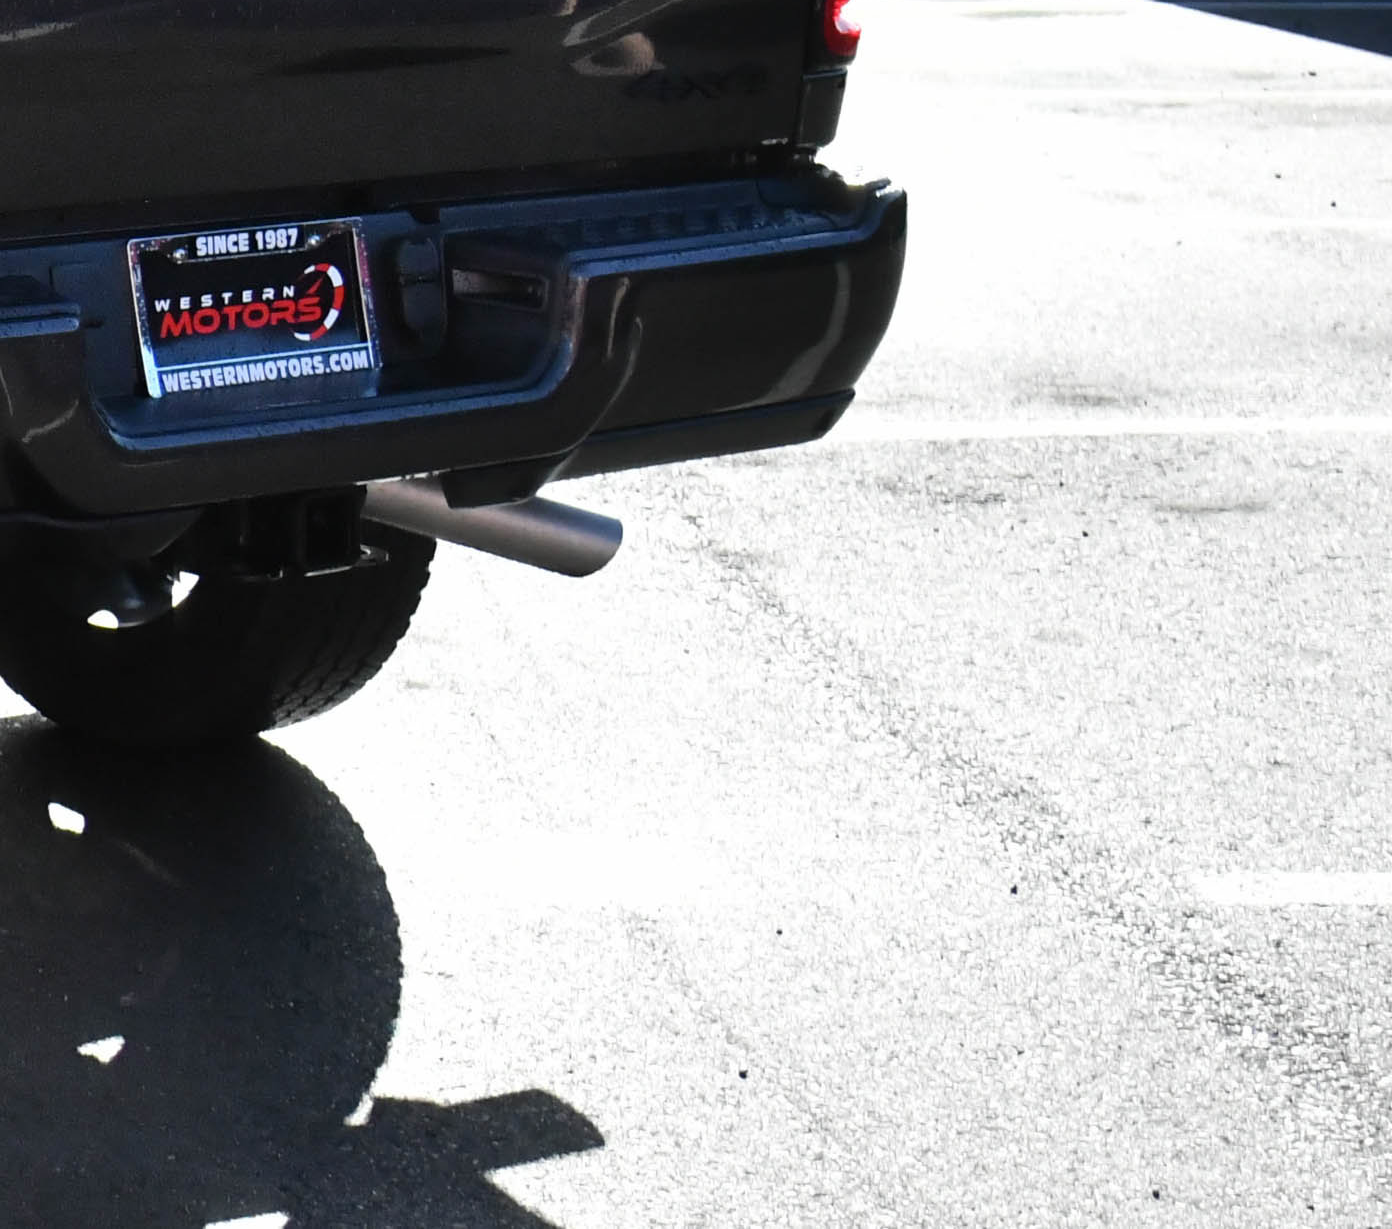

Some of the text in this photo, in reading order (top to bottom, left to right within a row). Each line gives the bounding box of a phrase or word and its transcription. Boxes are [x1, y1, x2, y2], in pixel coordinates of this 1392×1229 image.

[196, 227, 298, 257] SINCE 1987
[154, 284, 296, 313] WESTERN
[159, 296, 322, 339] MOTORS
[161, 350, 369, 394] WESTERNMOTORS.COM
